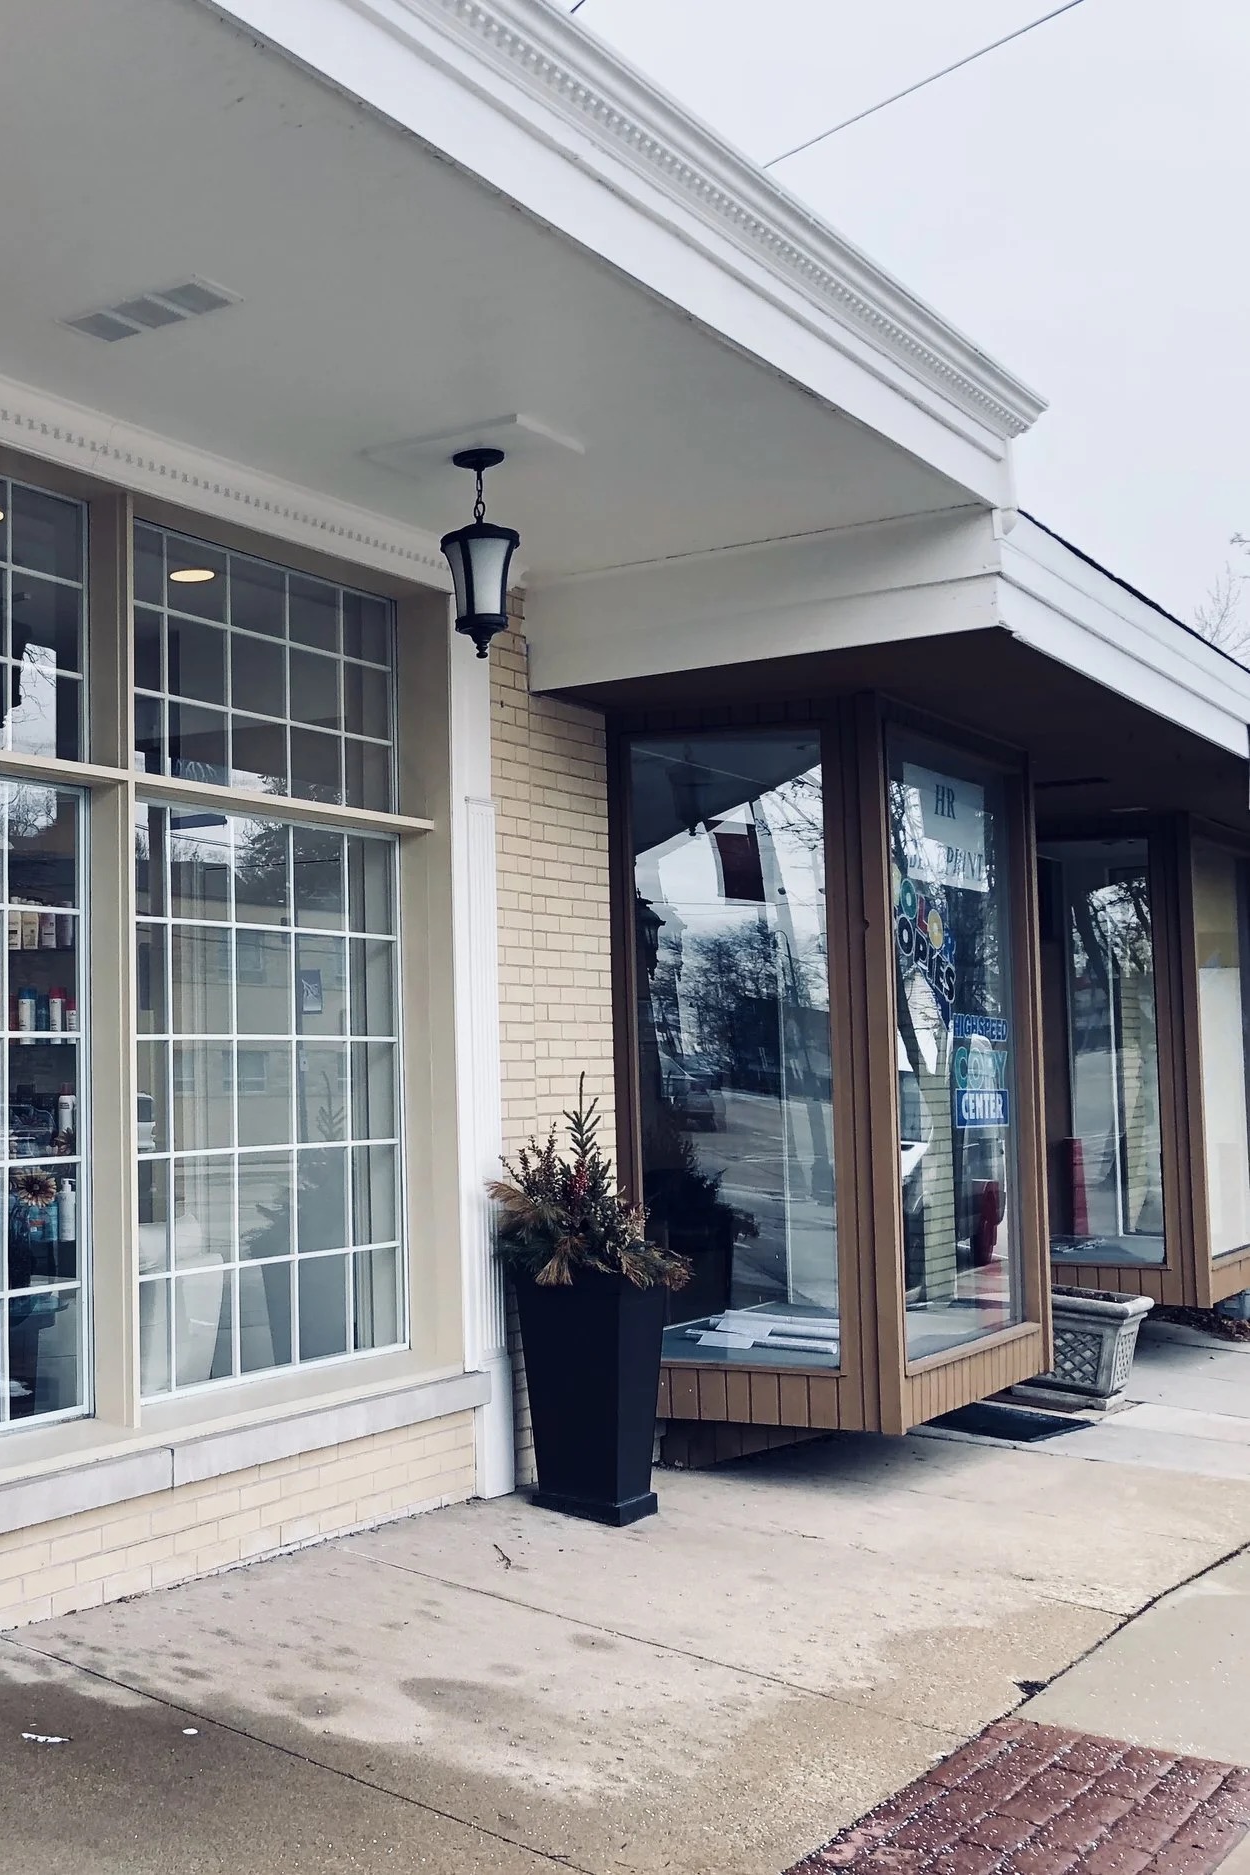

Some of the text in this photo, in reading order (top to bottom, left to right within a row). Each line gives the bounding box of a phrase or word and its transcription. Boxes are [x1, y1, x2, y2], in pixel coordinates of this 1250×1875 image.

[934, 784, 956, 820] HR
[893, 905, 957, 1003] OPIES
[961, 1092, 1004, 1120] CENTER
